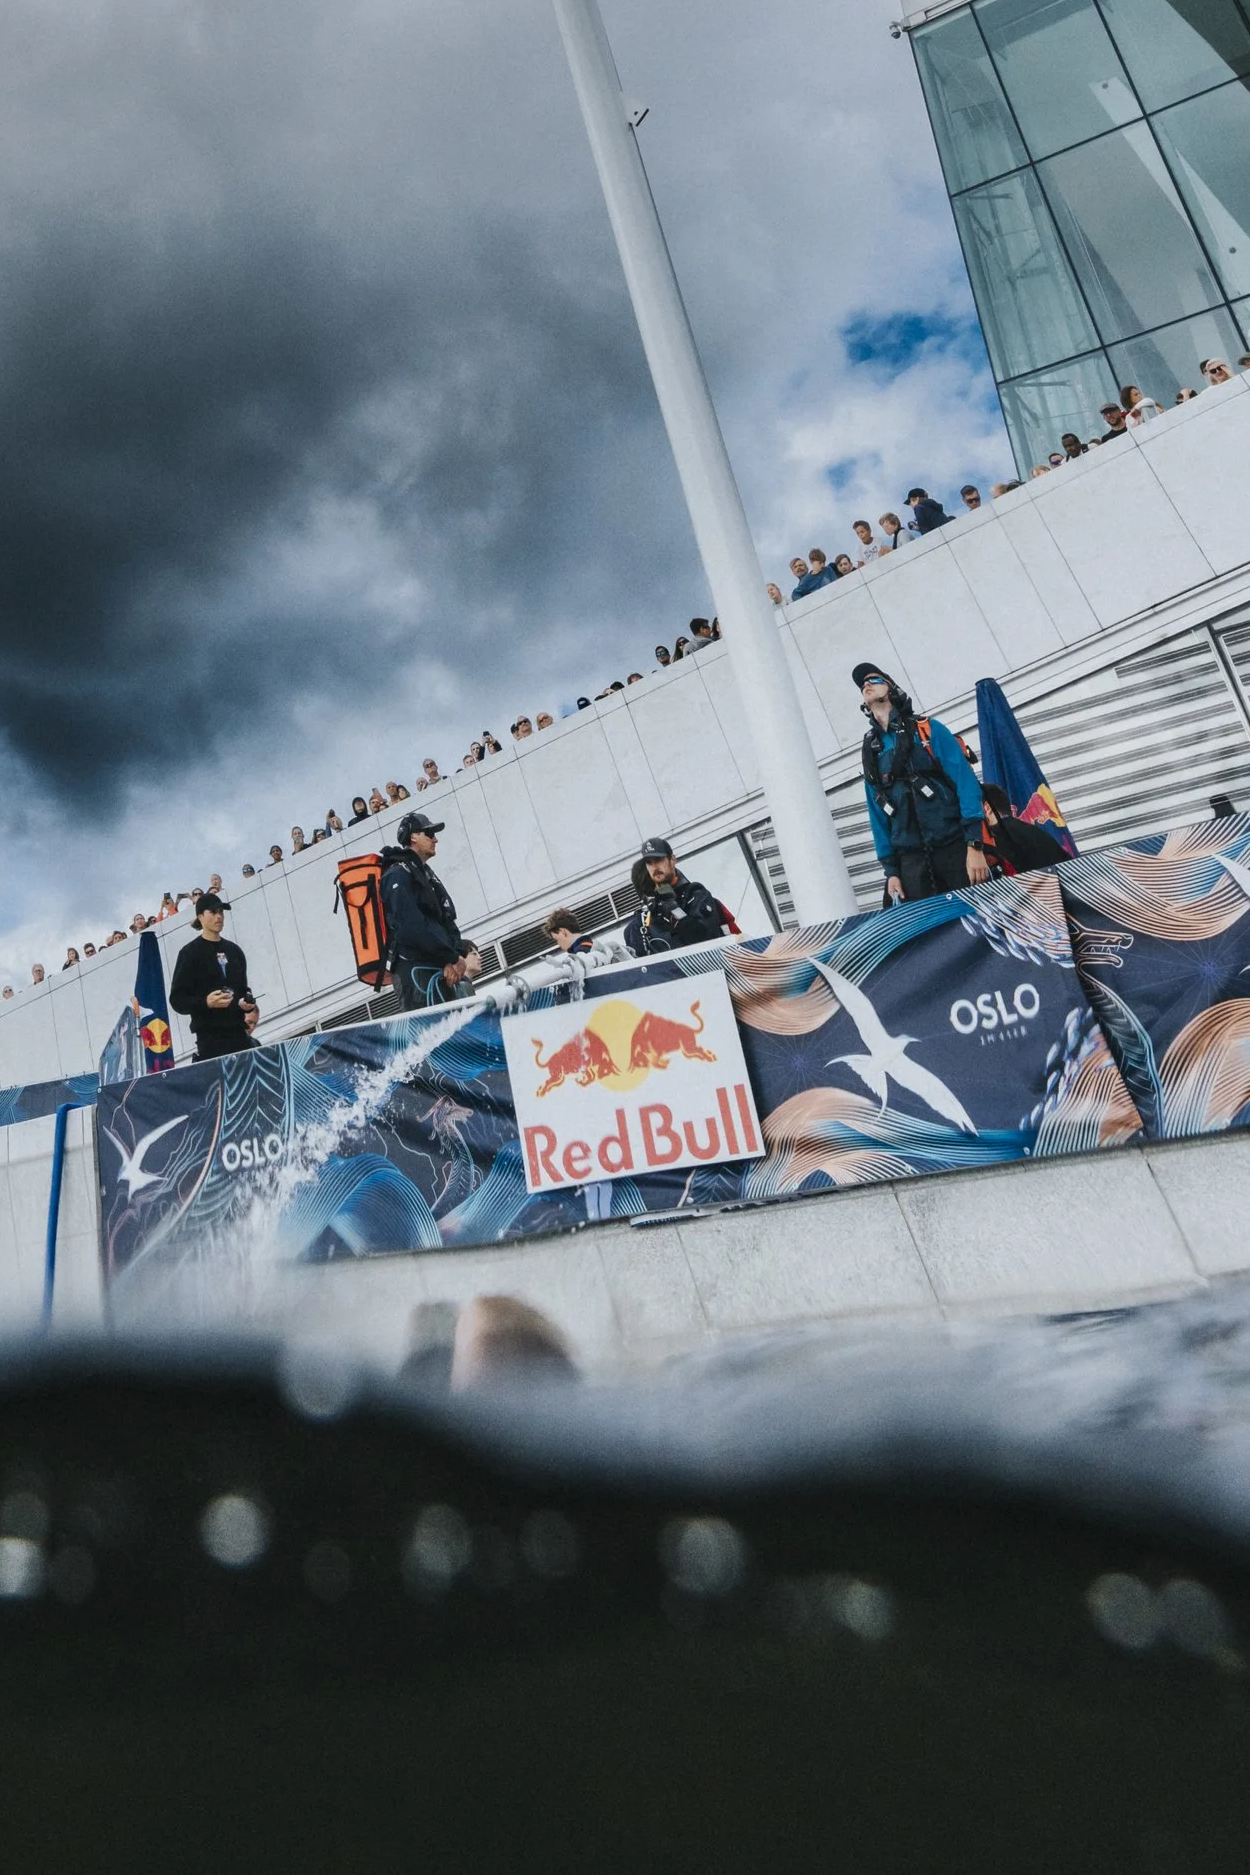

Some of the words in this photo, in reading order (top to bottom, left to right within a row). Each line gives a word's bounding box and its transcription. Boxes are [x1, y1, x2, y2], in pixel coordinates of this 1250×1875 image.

[950, 983, 1040, 1034] OSLO
[222, 1133, 282, 1172] OSLO
[524, 1108, 634, 1188] Red
[638, 1084, 758, 1166] Bull
